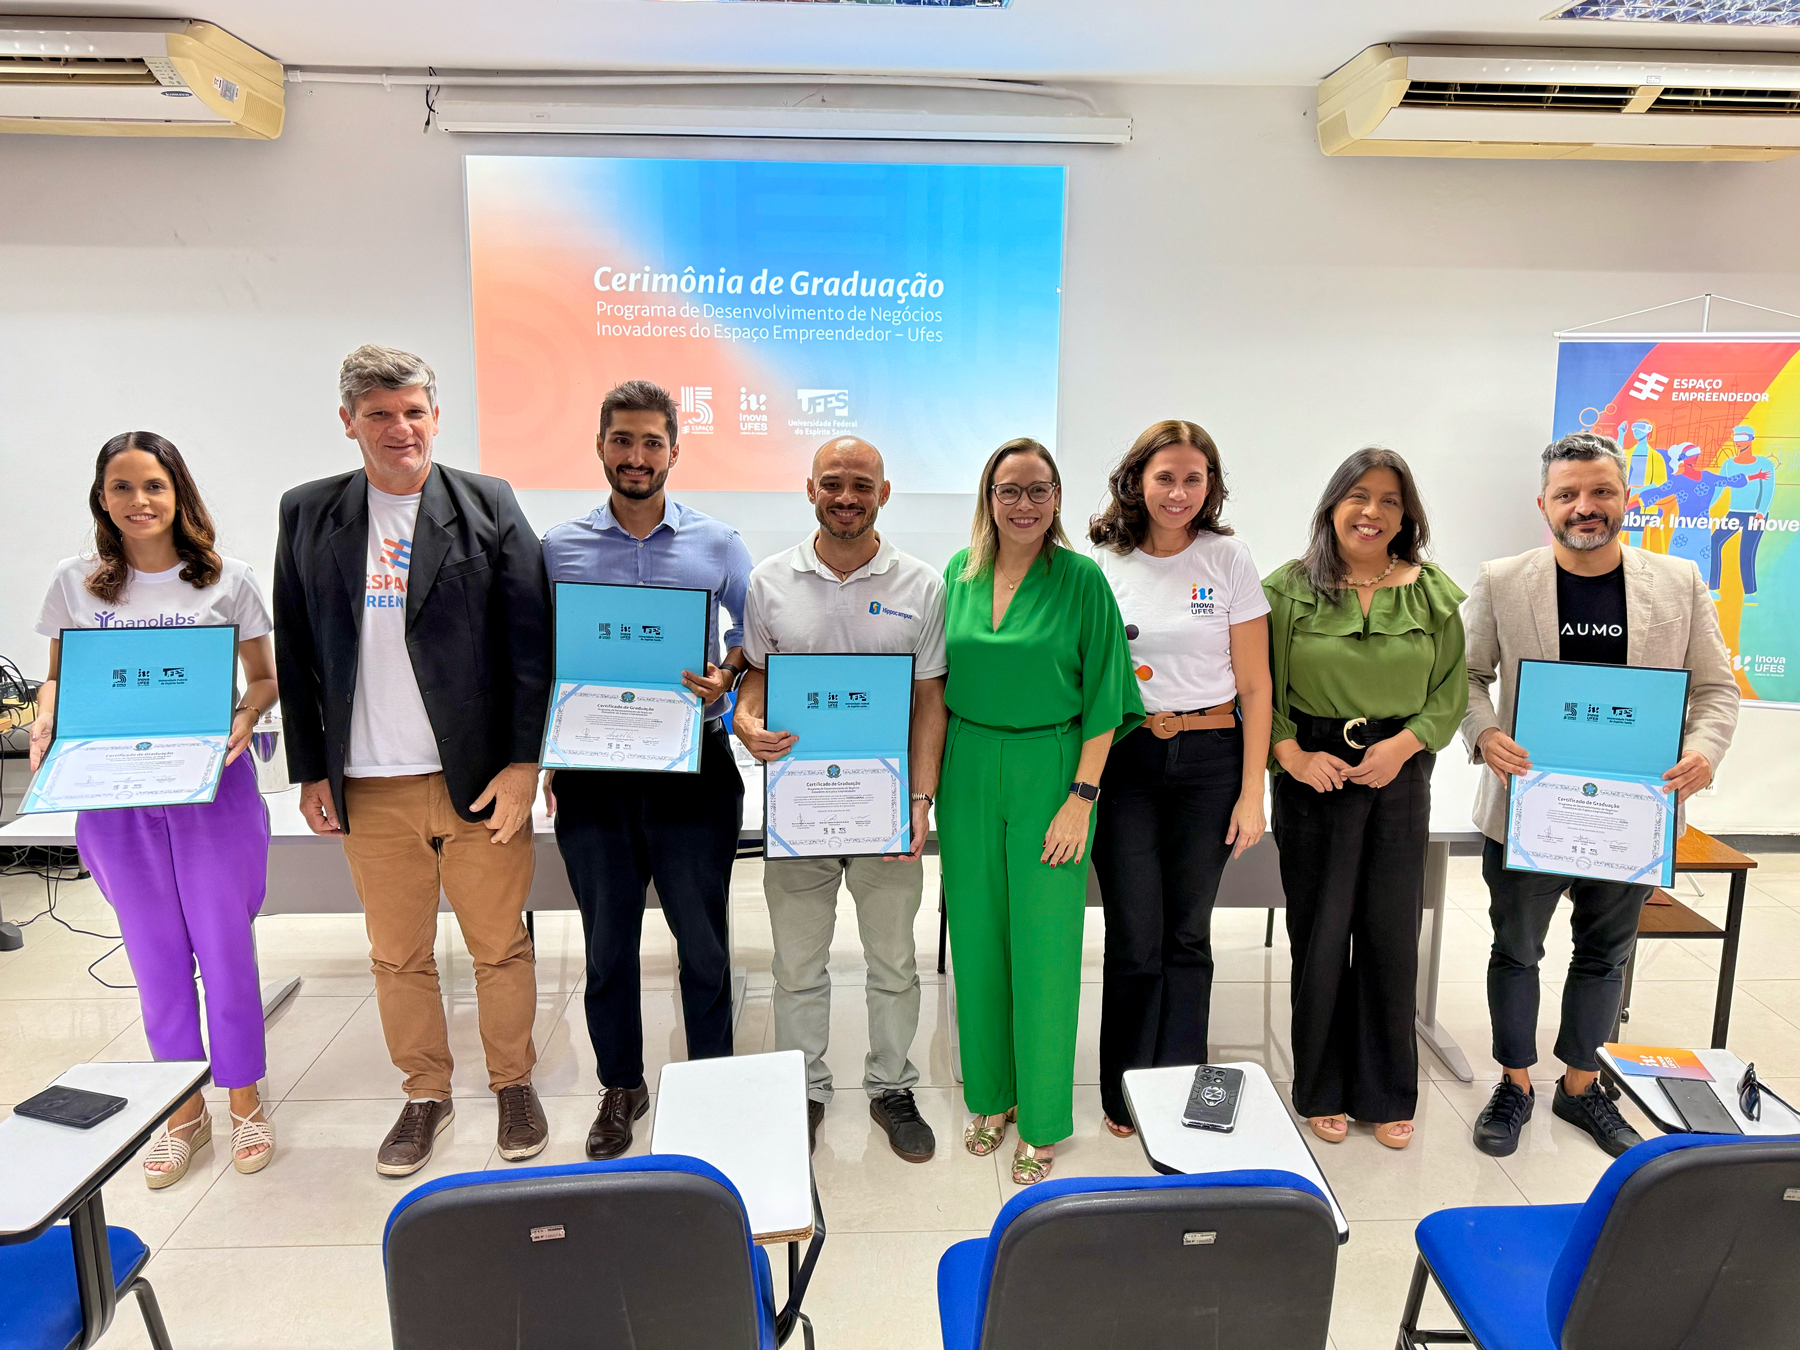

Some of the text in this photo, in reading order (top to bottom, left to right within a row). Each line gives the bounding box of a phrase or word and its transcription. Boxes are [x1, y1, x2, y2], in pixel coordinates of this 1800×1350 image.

[594, 266, 945, 304] Cerimônia de Graduação
[596, 301, 943, 325] Programa de Desenvolvimento de Negócios
[596, 321, 687, 337] Inovadores
[690, 322, 711, 338] do
[714, 323, 770, 343] Espaço
[773, 325, 892, 344] Empreendedor
[908, 326, 943, 342] Ufes
[1672, 378, 1723, 392] ESPAÇO
[1671, 391, 1770, 403] EMPREENDEDOR
[739, 413, 768, 422] Inova
[788, 419, 858, 428] Universidade Federal
[739, 422, 768, 432] UFES
[794, 427, 804, 435] do
[1621, 511, 1800, 532] ubra, Invente, Inove
[366, 595, 404, 609] REEN
[1560, 622, 1623, 638] AUMO
[1755, 654, 1786, 664] Inova
[1754, 663, 1785, 673] UFES
